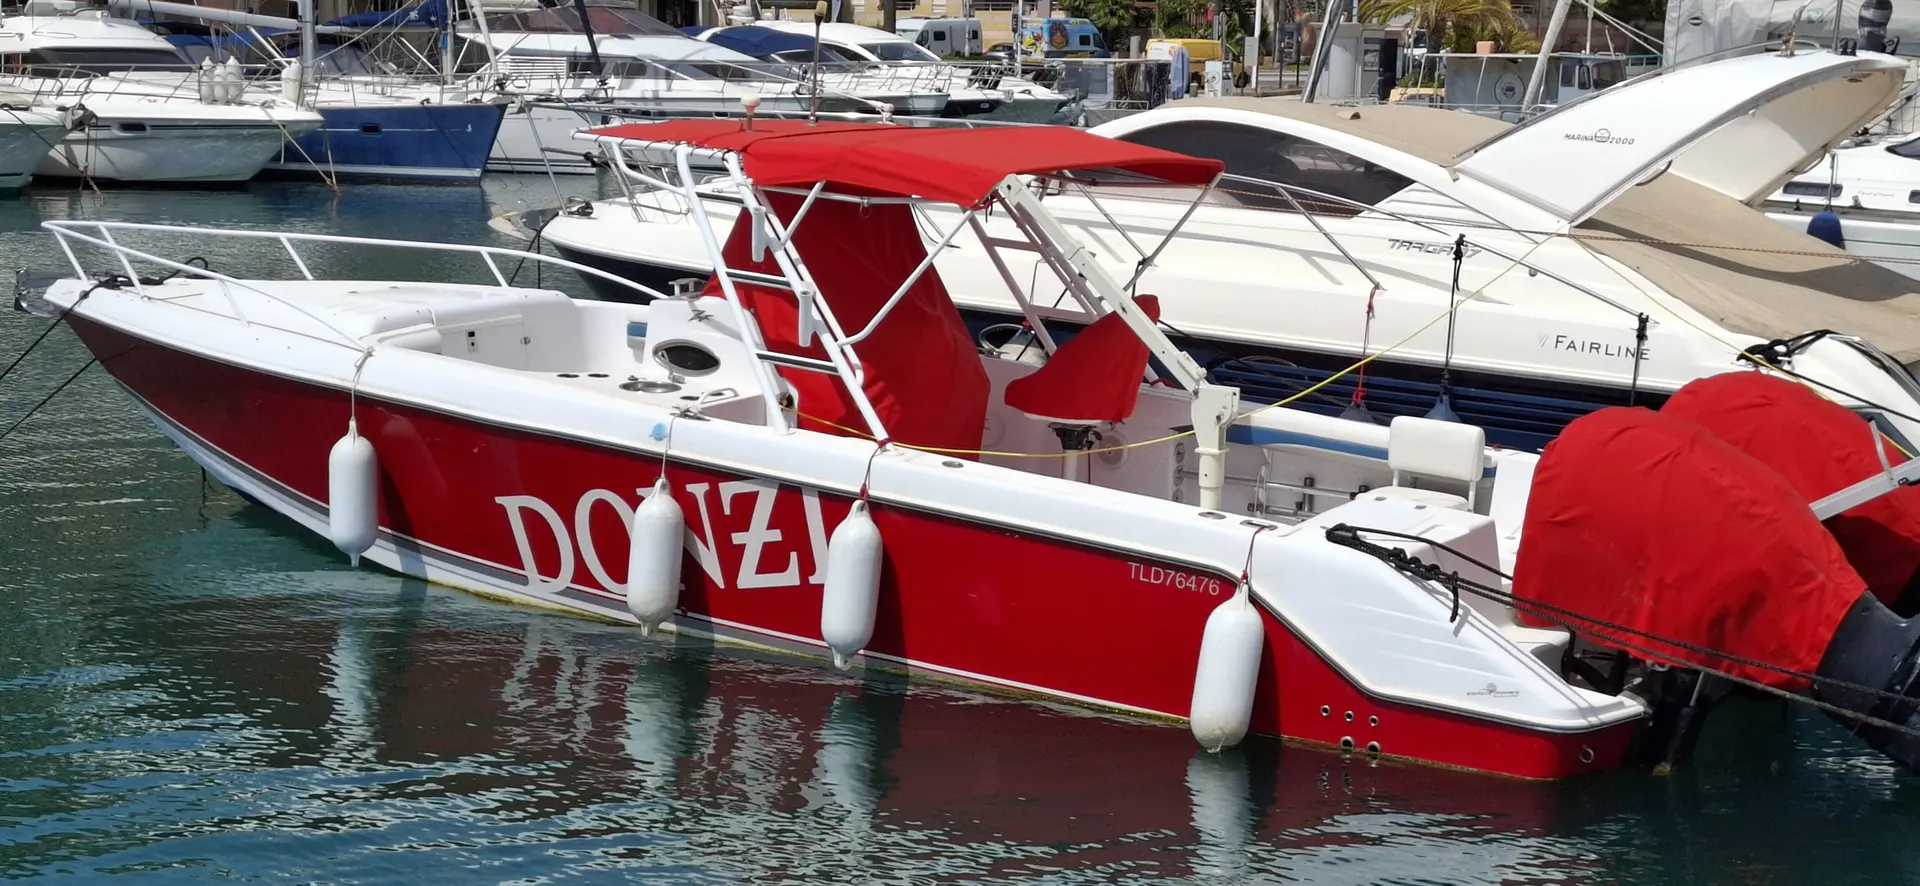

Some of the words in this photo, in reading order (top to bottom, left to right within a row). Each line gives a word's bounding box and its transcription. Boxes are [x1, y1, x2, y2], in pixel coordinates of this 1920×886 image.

[1564, 132, 1594, 142] MARINA
[1609, 136, 1635, 146] 2000
[1388, 238, 1455, 256] TARGA
[1554, 334, 1651, 361] FAIRLINE
[1127, 561, 1221, 596] TLD76476
